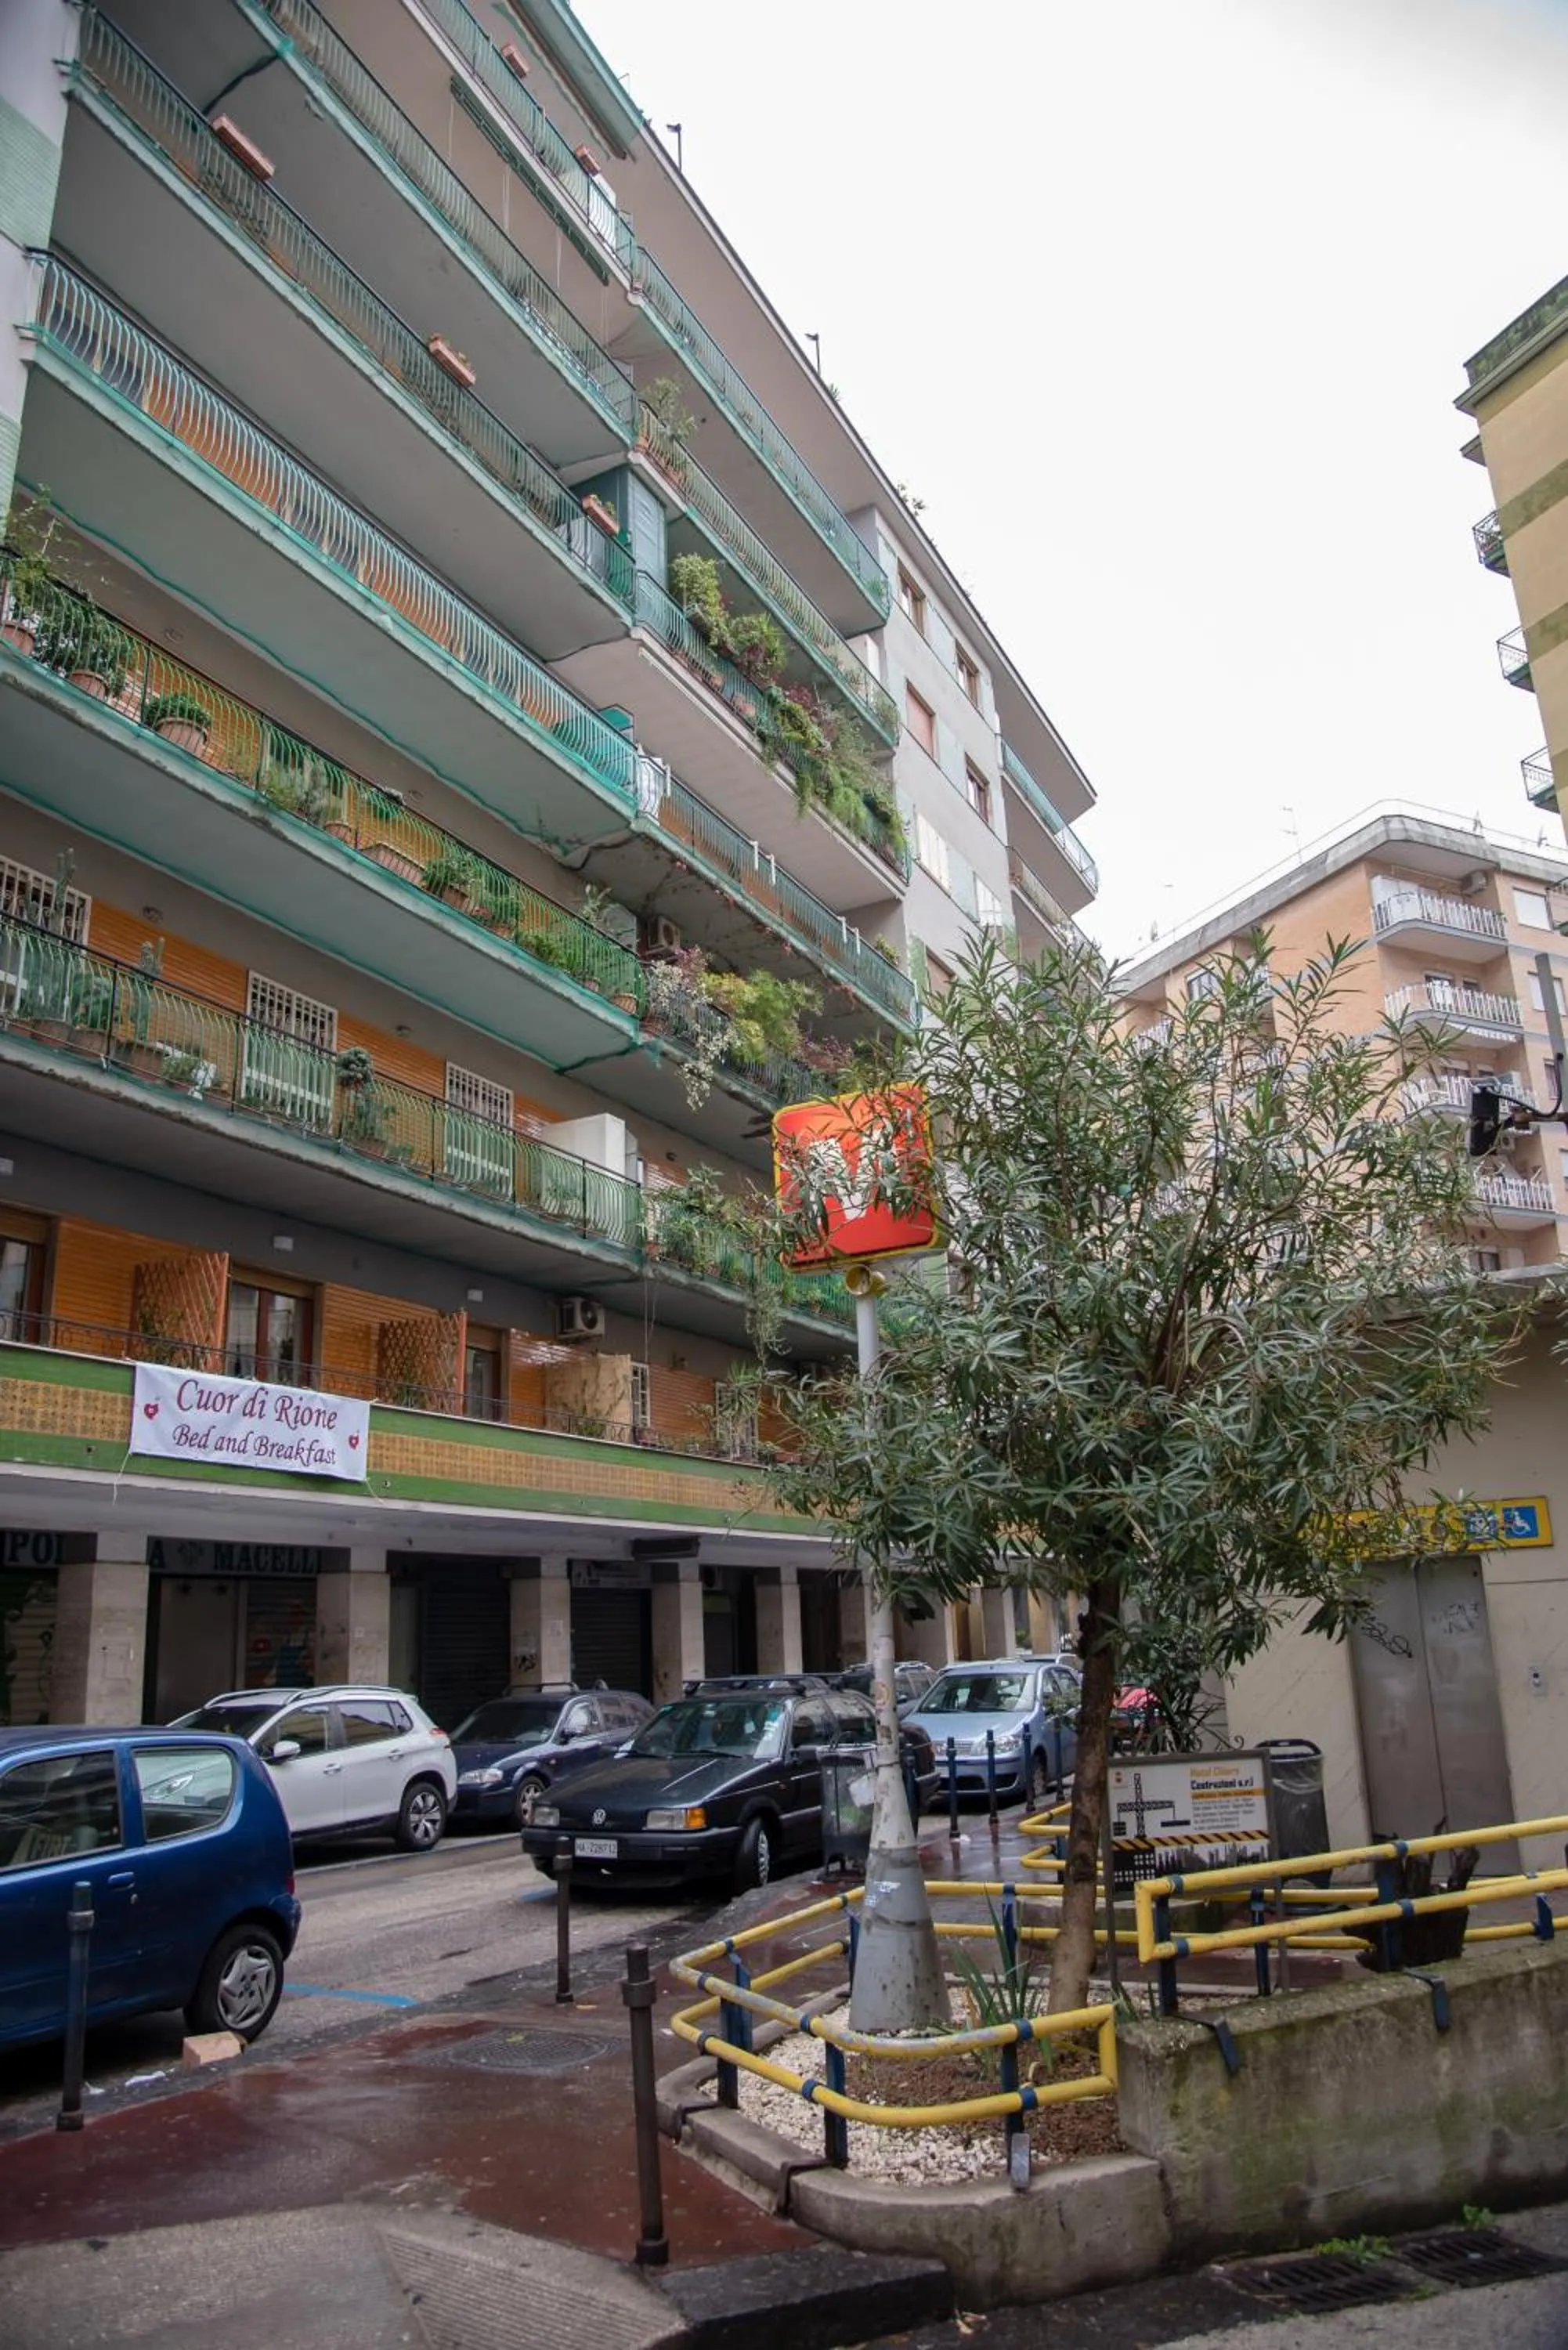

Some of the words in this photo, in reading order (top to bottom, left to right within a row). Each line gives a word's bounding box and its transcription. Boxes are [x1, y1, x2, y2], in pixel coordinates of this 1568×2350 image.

[177, 1379, 238, 1413] Cuor
[243, 1386, 269, 1420] di
[275, 1395, 337, 1430] Rione
[173, 1423, 216, 1447] Bed
[214, 1431, 254, 1455] and
[253, 1435, 336, 1466] Breakfast
